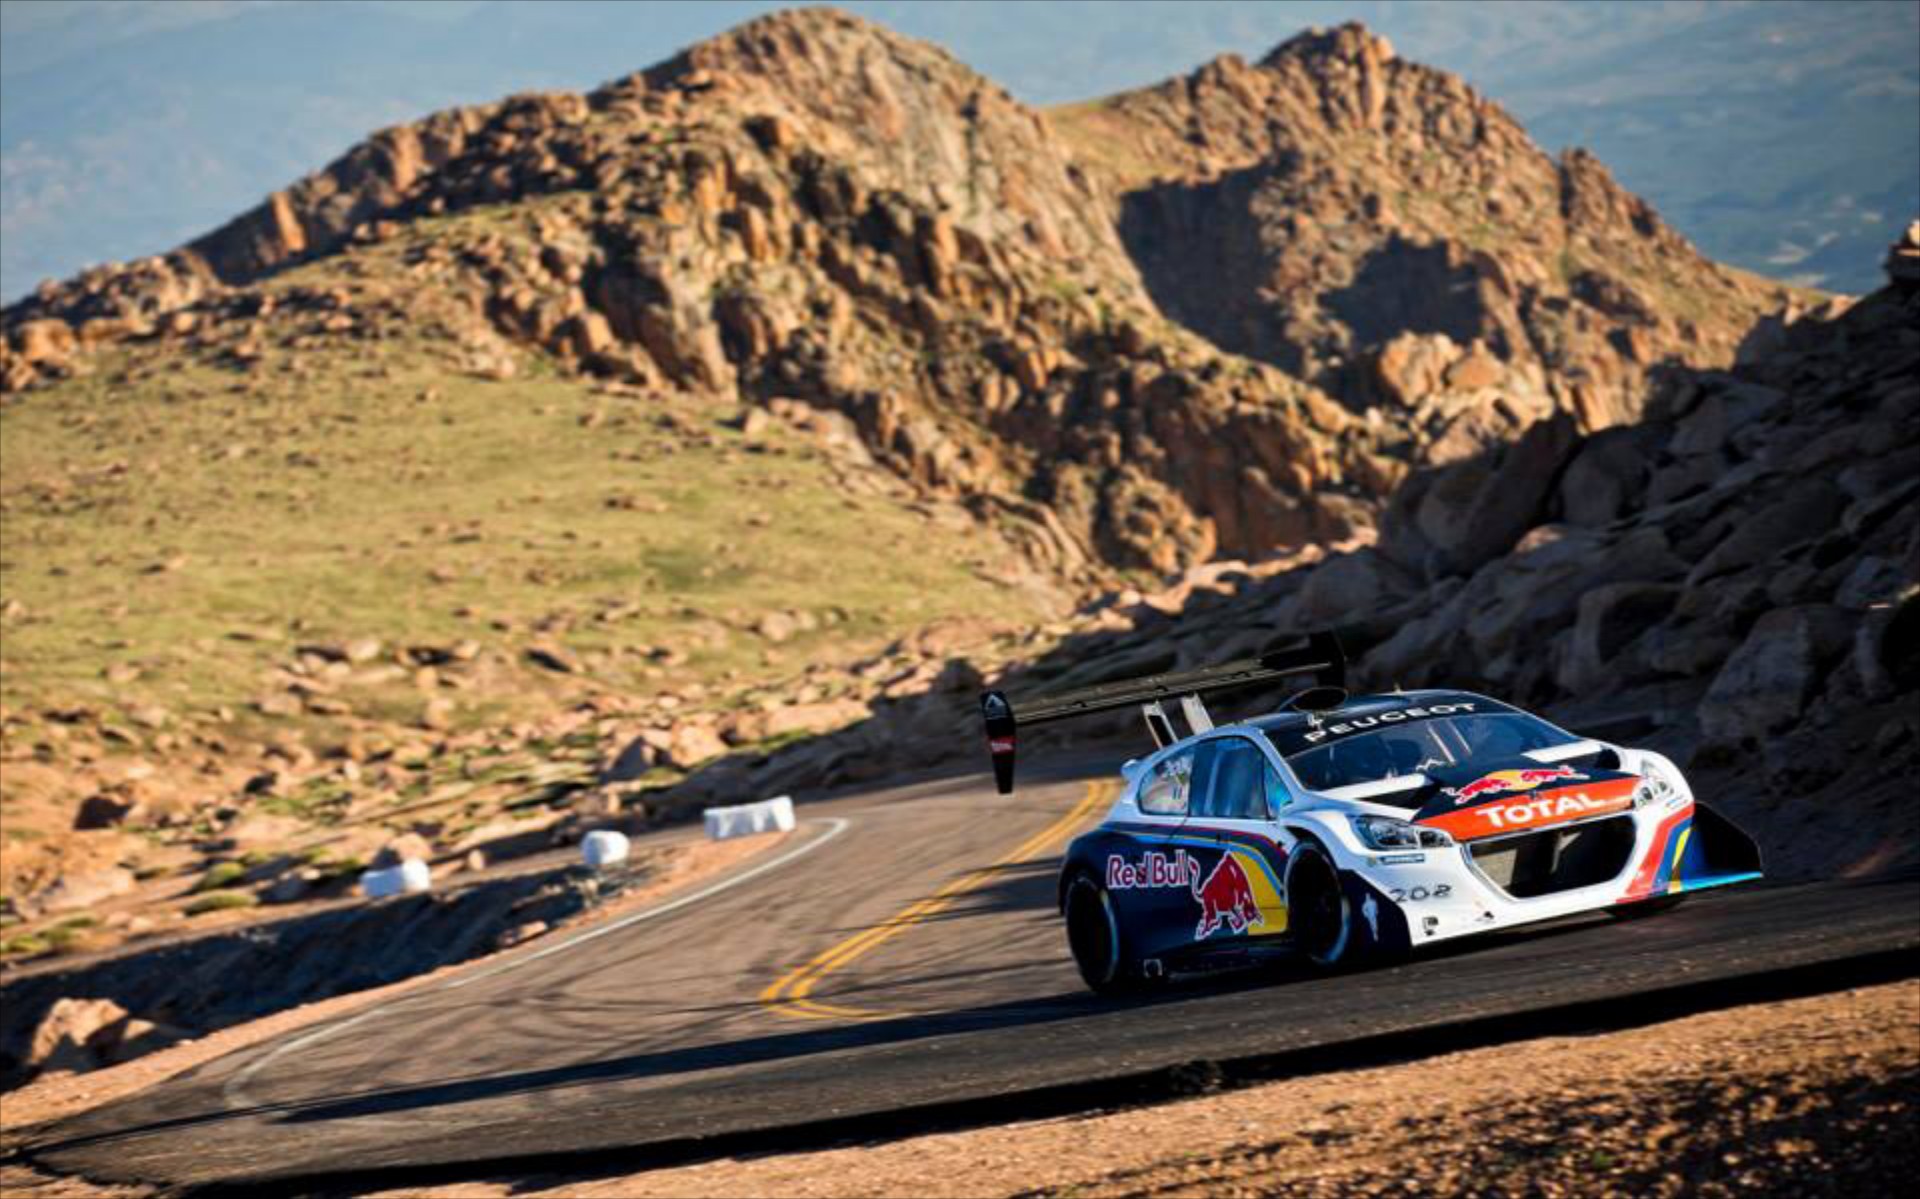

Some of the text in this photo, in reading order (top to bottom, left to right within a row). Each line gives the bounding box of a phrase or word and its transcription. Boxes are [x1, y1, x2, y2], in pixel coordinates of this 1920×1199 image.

[1304, 703, 1475, 743] PEUGEOT
[1475, 793, 1605, 828] TOTAL
[1107, 850, 1190, 889] Red Bull
[1389, 884, 1452, 903] 208
